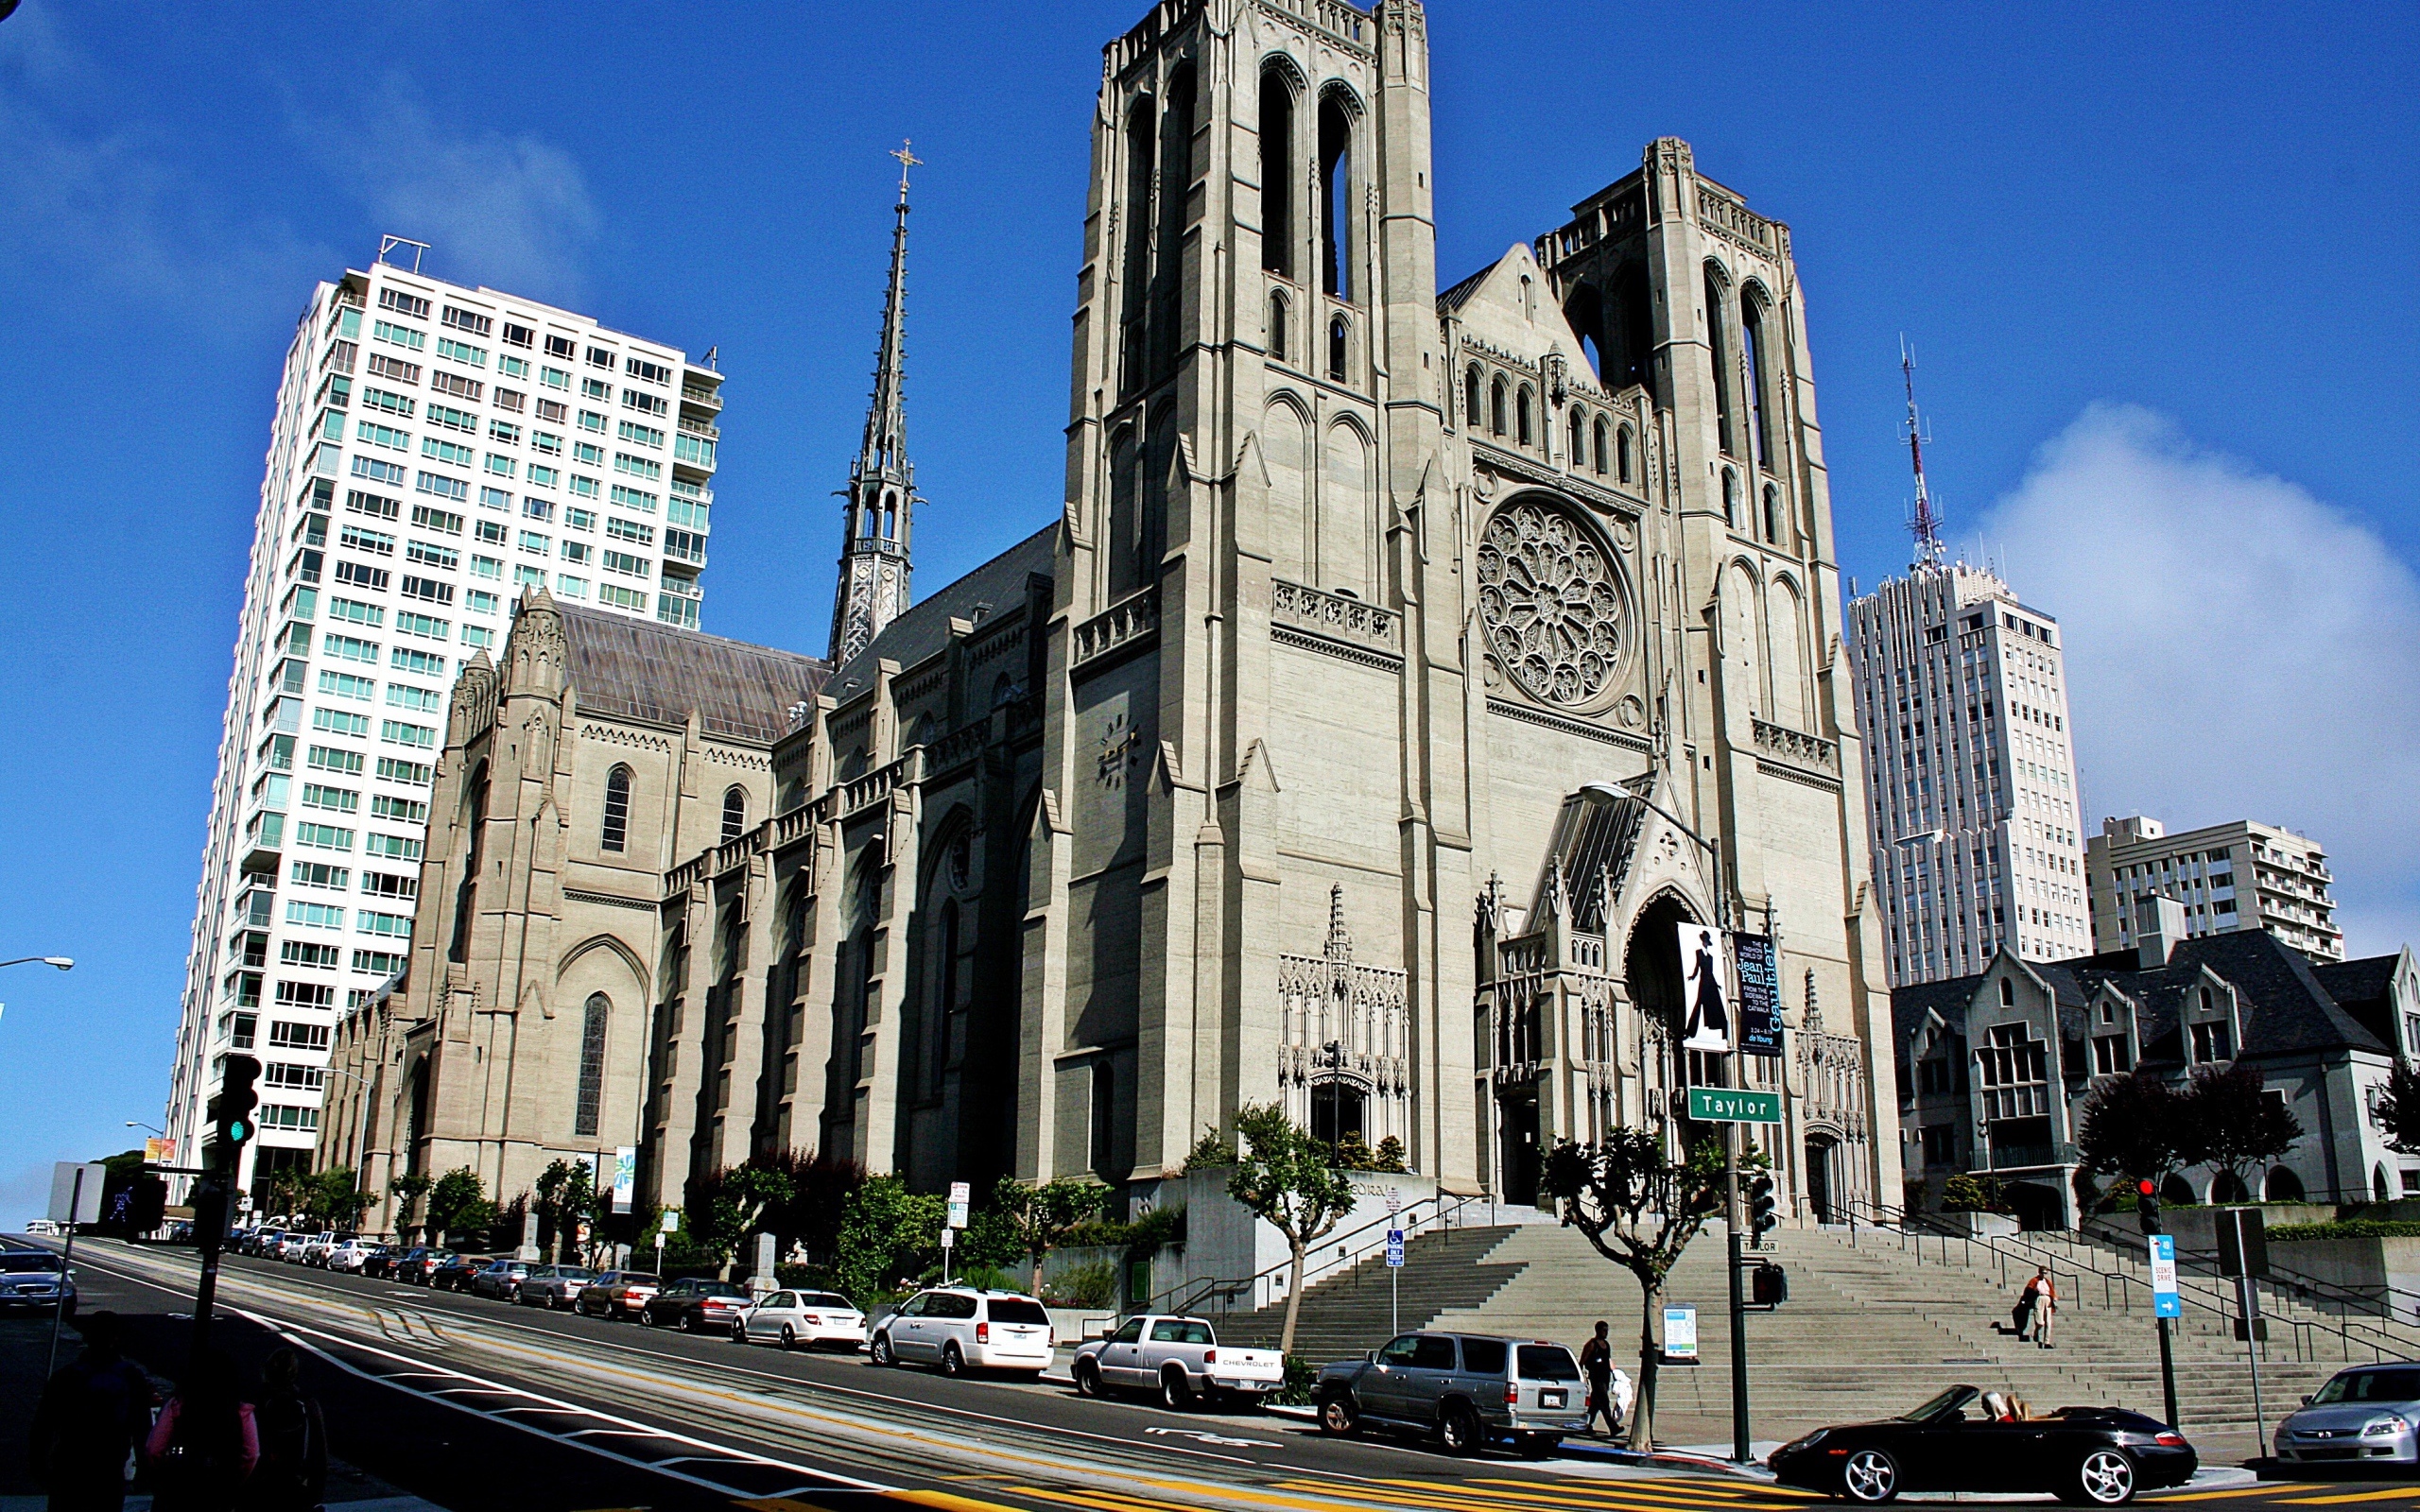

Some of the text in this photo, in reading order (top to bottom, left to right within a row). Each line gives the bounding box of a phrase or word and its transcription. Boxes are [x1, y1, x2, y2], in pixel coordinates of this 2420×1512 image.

[1737, 958, 1763, 972] Jean
[1741, 971, 1765, 985] Paul
[1764, 943, 1781, 1032] Gaultier
[1756, 1035, 1773, 1045] Young
[1703, 1095, 1766, 1117] Taylor
[1745, 1243, 1775, 1251] TALOR
